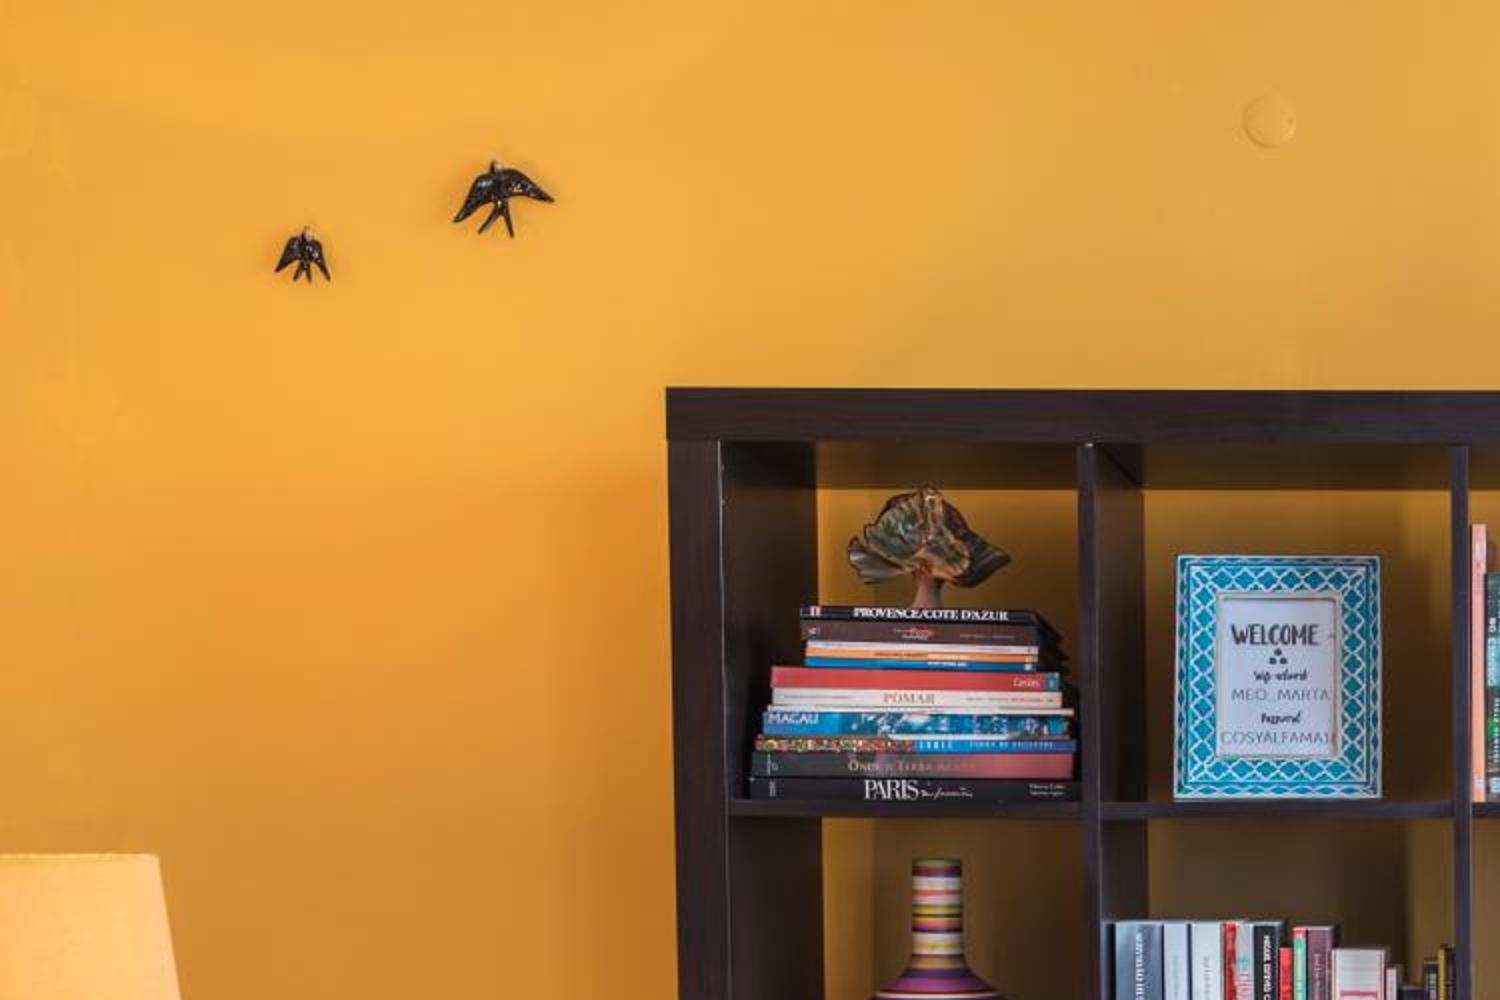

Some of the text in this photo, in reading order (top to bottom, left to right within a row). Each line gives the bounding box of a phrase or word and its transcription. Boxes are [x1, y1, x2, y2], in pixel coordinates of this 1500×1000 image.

[1230, 623, 1321, 646] WELCOME
[767, 712, 819, 725] MACAU
[864, 779, 919, 801] PARIS
